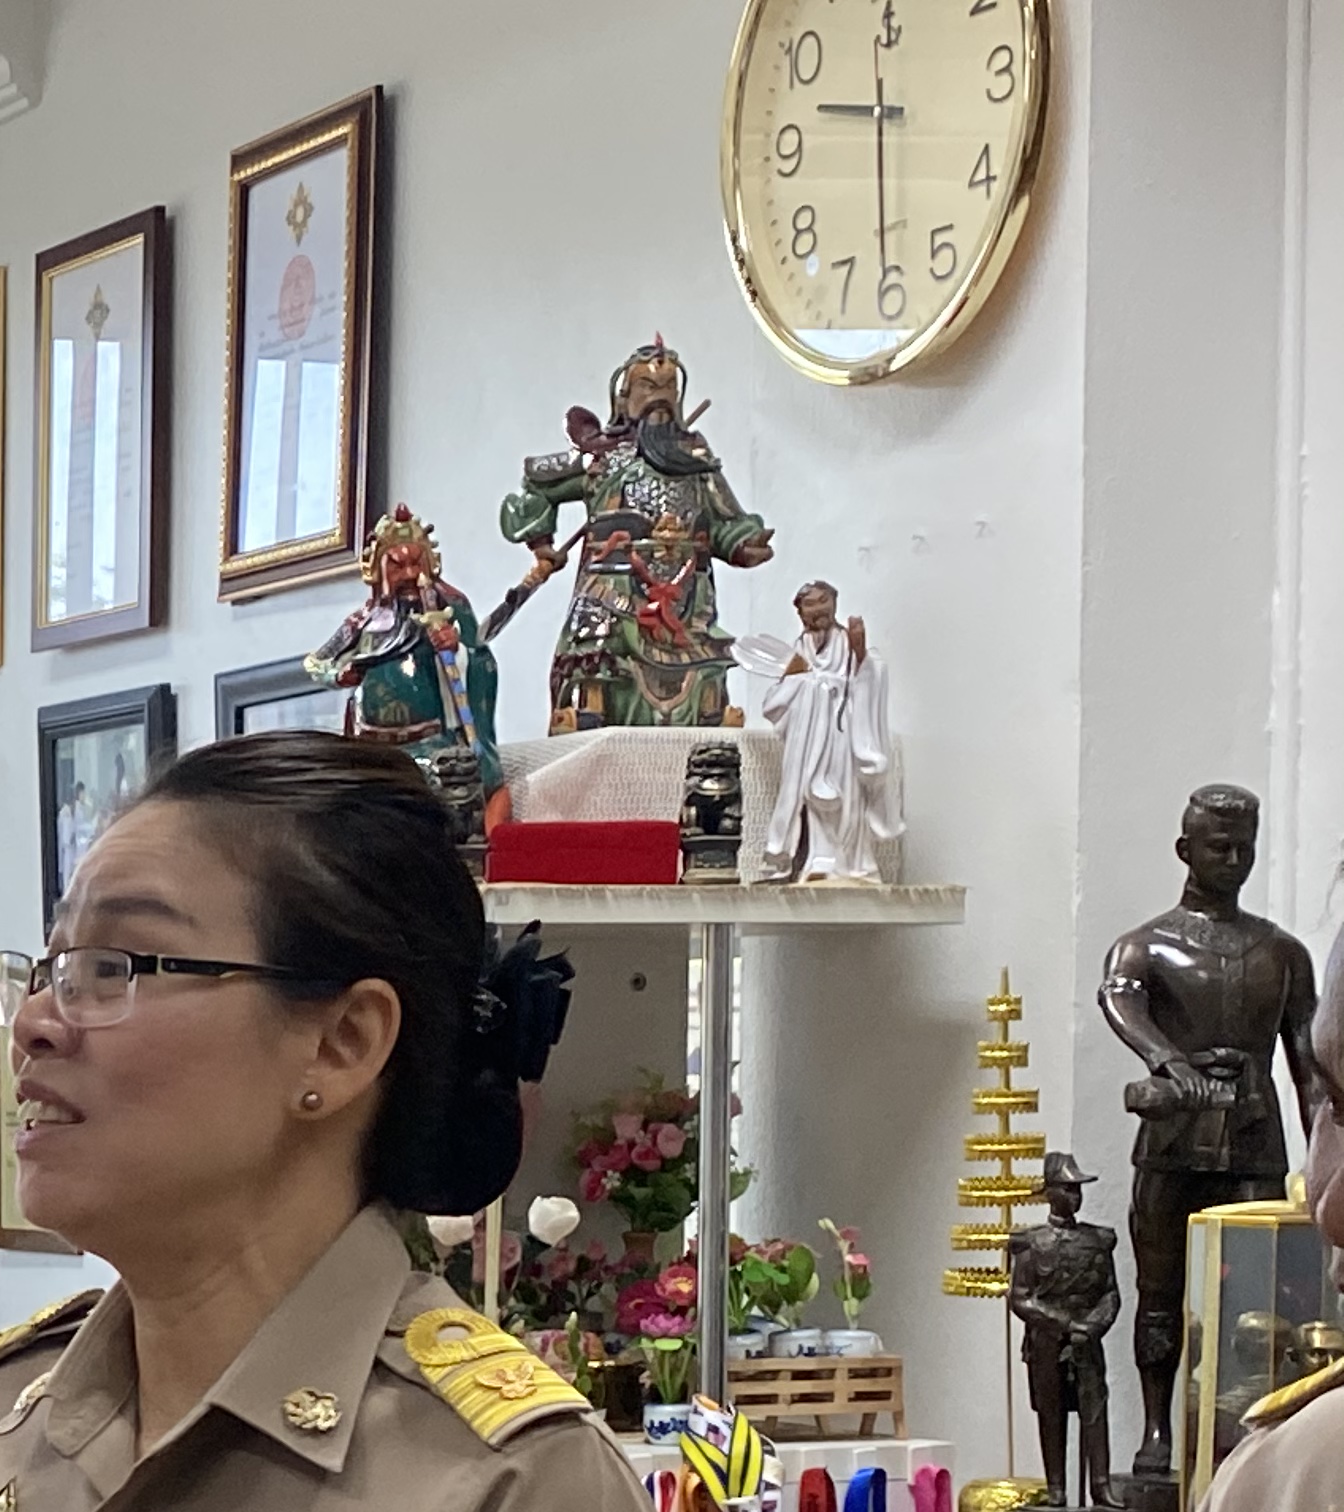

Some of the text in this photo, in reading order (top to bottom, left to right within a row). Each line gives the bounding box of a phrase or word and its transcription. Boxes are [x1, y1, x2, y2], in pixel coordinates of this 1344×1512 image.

[784, 29, 822, 90] 10
[986, 44, 1016, 103] 3
[776, 124, 803, 177] 9
[967, 143, 997, 199] 4
[791, 205, 817, 260] 8
[929, 222, 958, 281] 5
[831, 256, 856, 315] 7
[877, 265, 907, 321] 6
